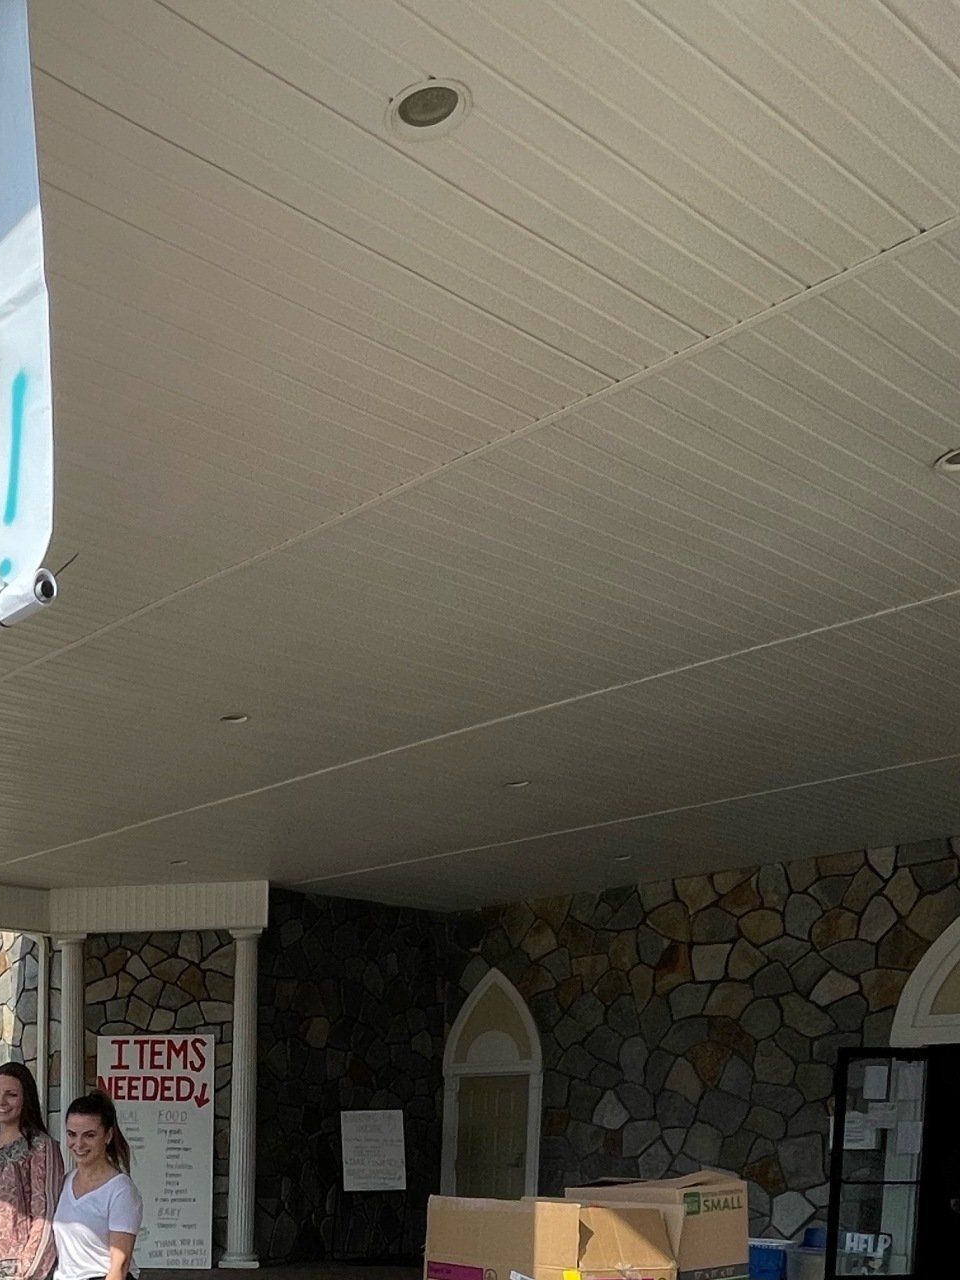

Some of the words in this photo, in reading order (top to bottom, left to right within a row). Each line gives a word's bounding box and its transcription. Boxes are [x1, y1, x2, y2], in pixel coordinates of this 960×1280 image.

[110, 1037, 208, 1072] ITEMS
[97, 1075, 195, 1101] NEEDED
[158, 1109, 188, 1121] FOOD
[703, 1196, 743, 1212] SMALL
[844, 1232, 892, 1259] HELP
